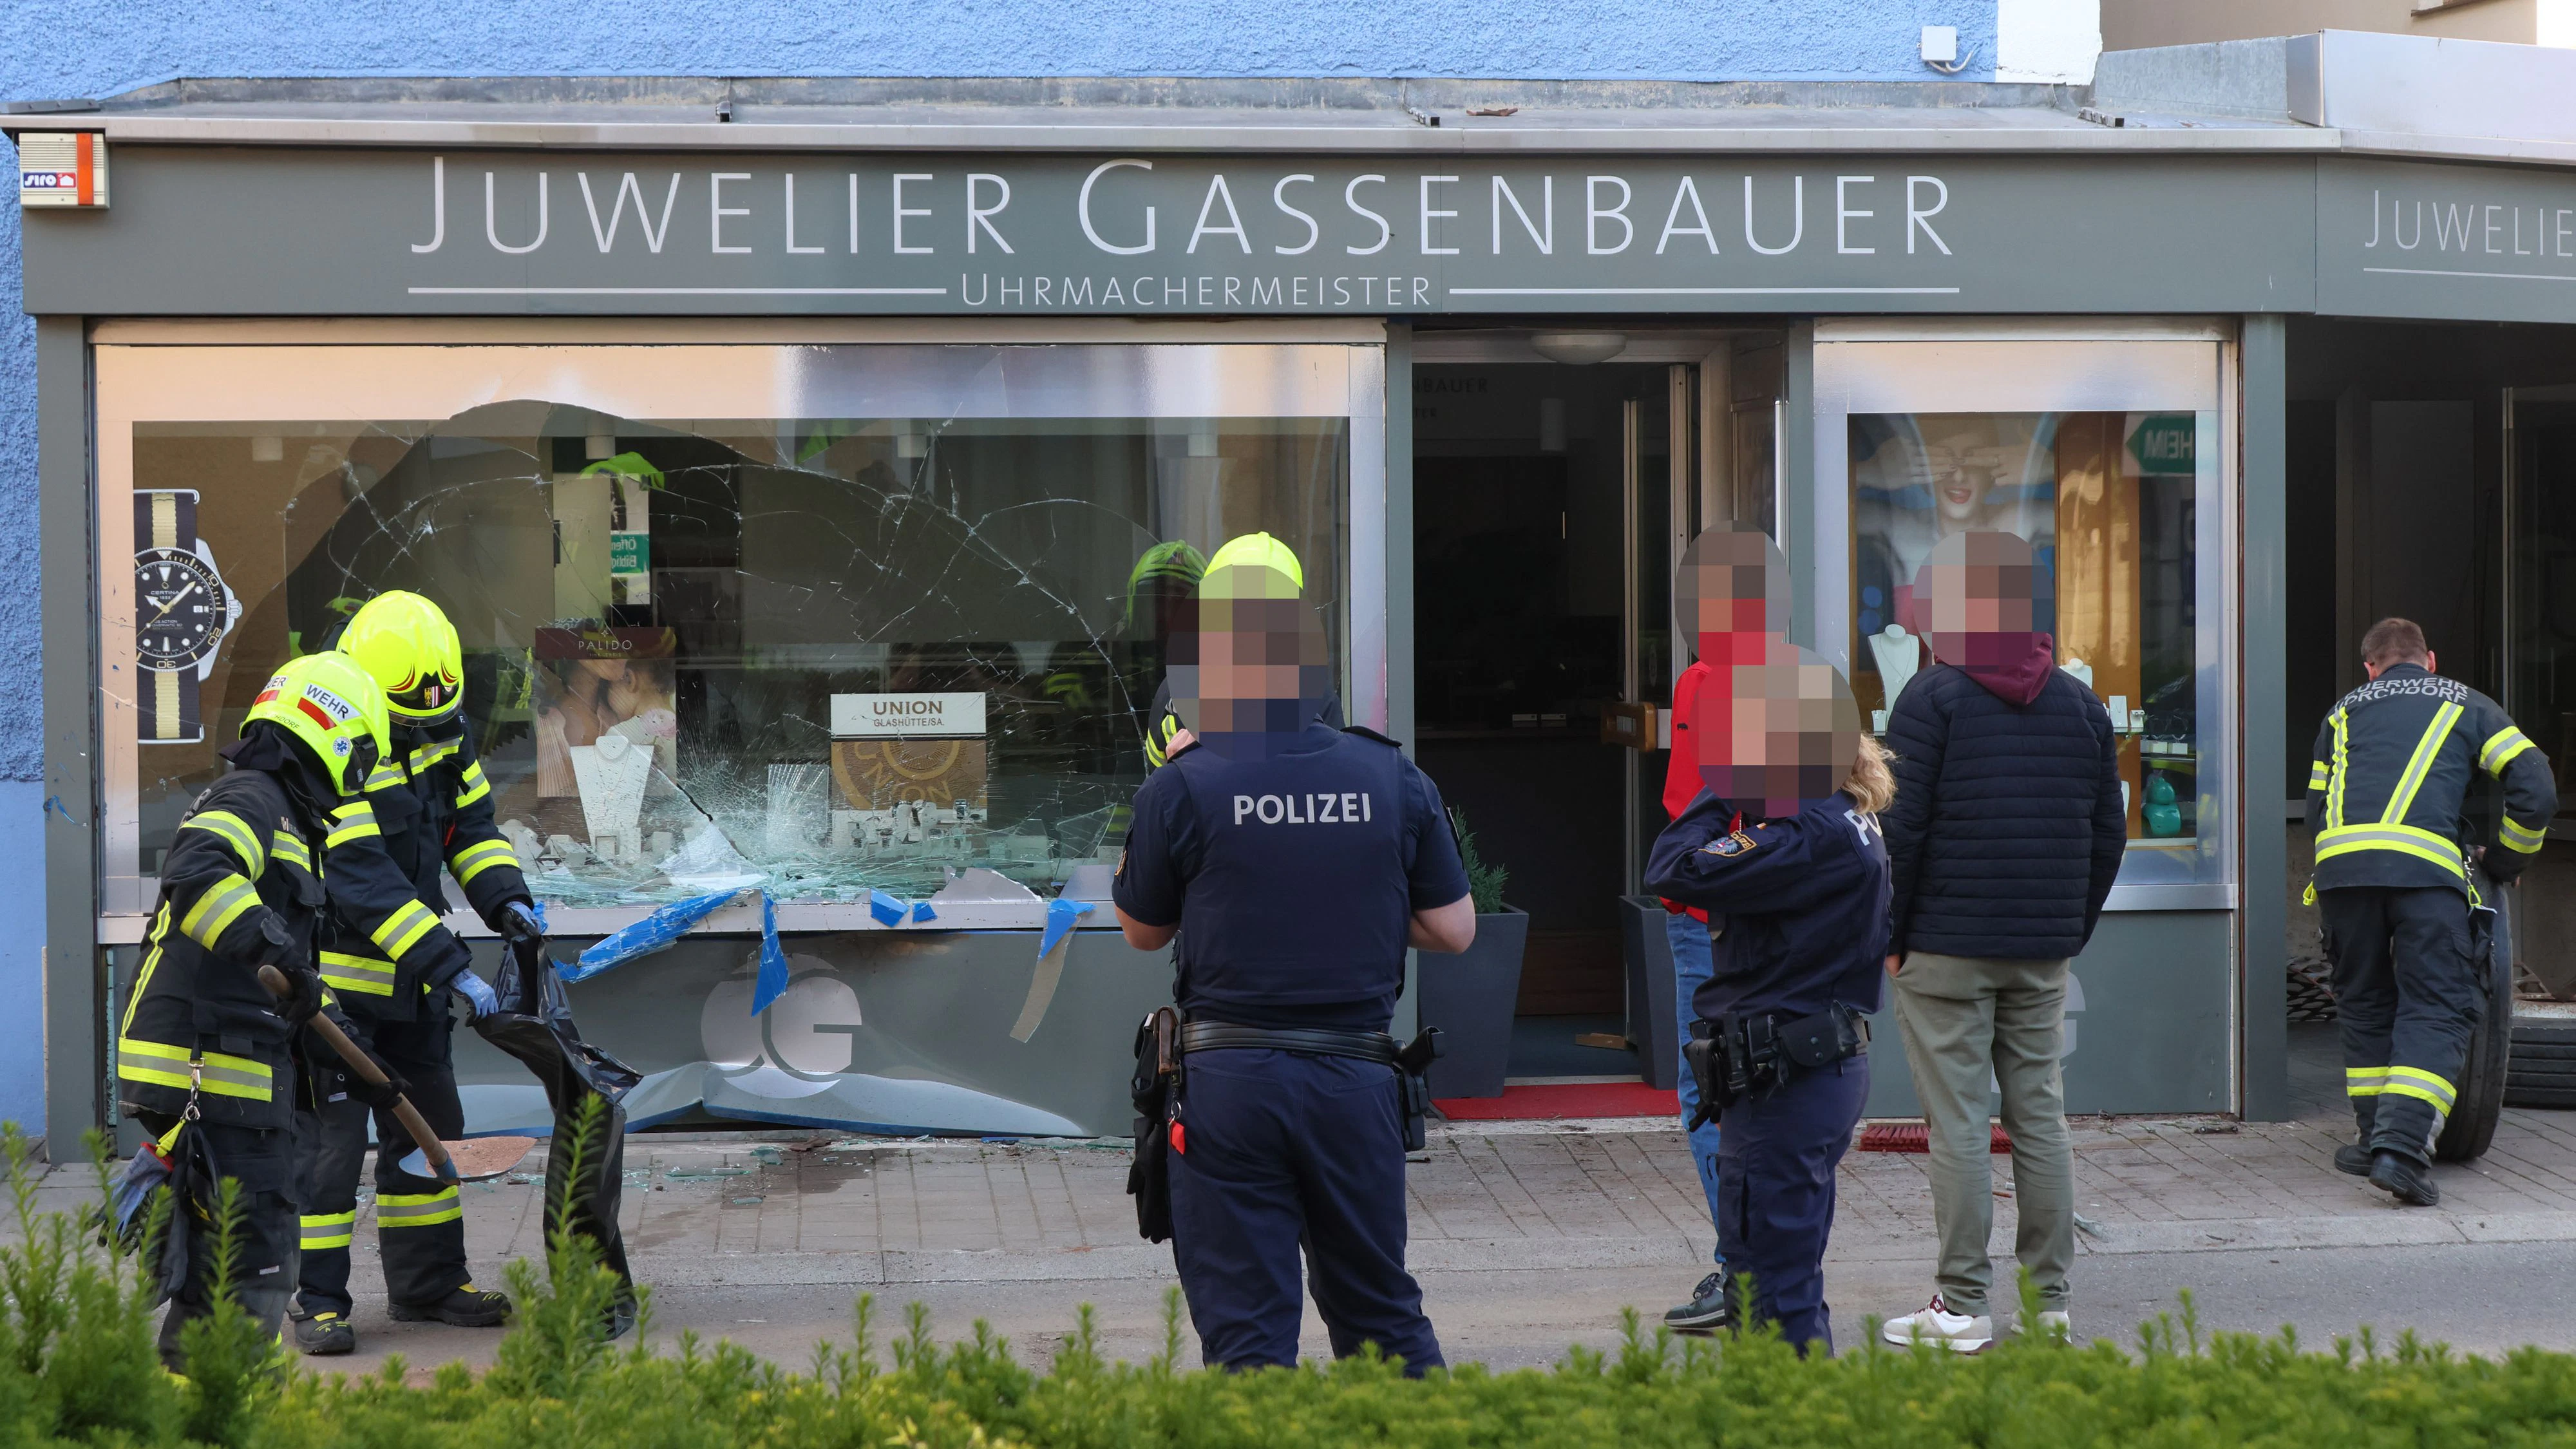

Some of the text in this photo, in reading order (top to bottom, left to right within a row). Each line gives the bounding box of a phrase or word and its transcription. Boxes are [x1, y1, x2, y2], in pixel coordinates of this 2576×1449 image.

[1079, 158, 1953, 255] GASSENBAUER
[962, 273, 1430, 307] UHRMACHERMEISTER
[578, 640, 632, 650] PALIDO
[265, 676, 349, 719] UER WEHR
[873, 700, 943, 715] UNION
[1234, 793, 1370, 825] POLIZEI
